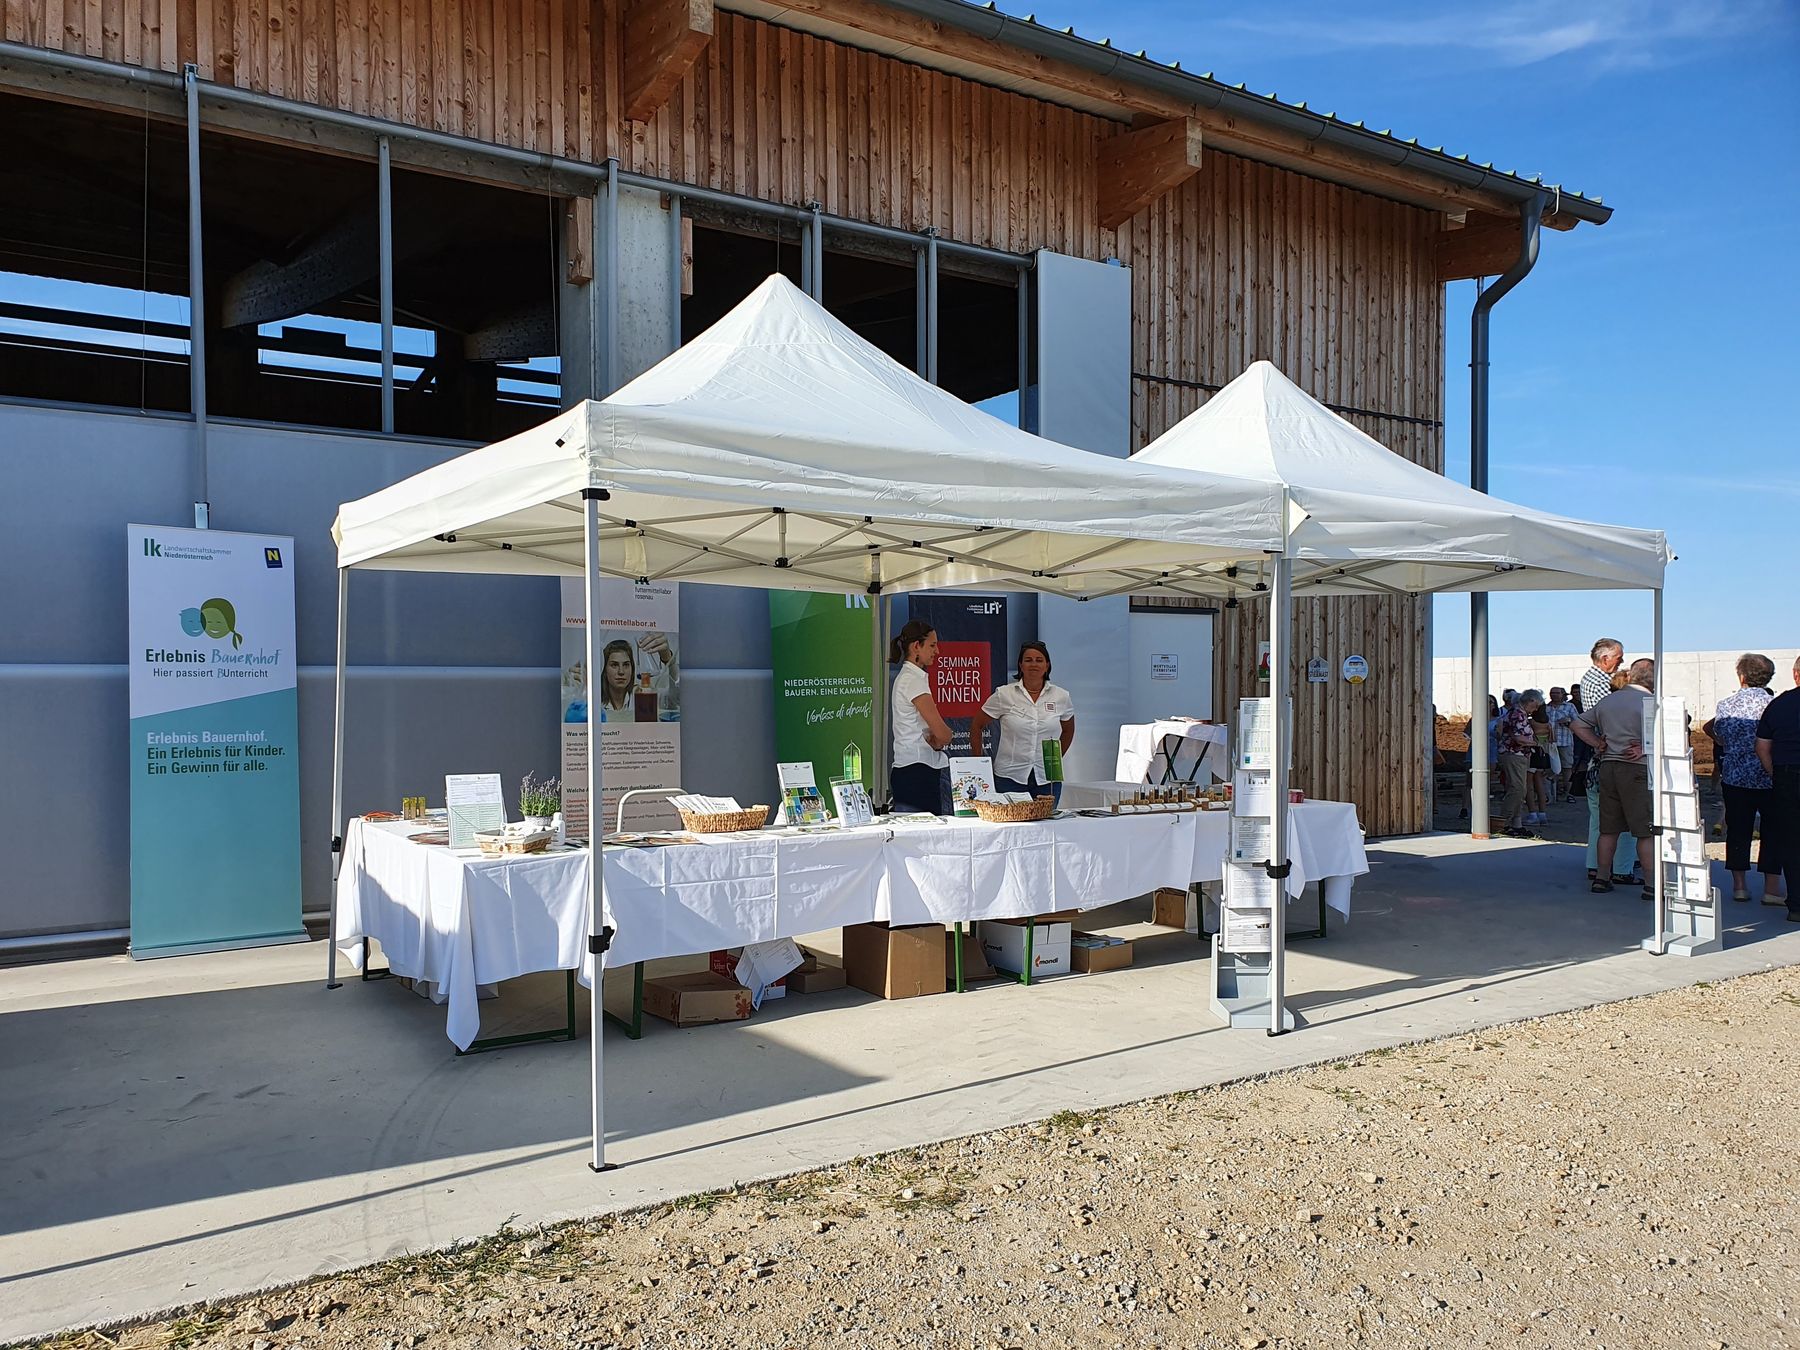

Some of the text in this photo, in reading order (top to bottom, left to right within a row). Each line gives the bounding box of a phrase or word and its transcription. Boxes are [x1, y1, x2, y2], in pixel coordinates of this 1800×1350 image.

[144, 538, 162, 557] lk
[164, 545, 232, 555] Landwirtschaftskammer
[164, 551, 214, 561] Niederösterreich
[267, 550, 279, 561] N
[145, 649, 206, 663] Erlebnis
[937, 656, 980, 668] SEMINAR
[153, 668, 173, 678] Hier
[176, 668, 214, 678] passiert
[937, 667, 981, 686] BÄUER
[784, 677, 865, 687] NIEDERÖSTERREICHS
[785, 686, 873, 697] BAUERN. EINE KAMMER
[937, 687, 981, 702] INNEN
[147, 730, 268, 744] Erlebnis Bauernhof.
[148, 744, 285, 759] Ein Erlebnis für Kinder.
[148, 759, 268, 774] Ein Gewinn für alle.
[1040, 957, 1058, 965] mondi
